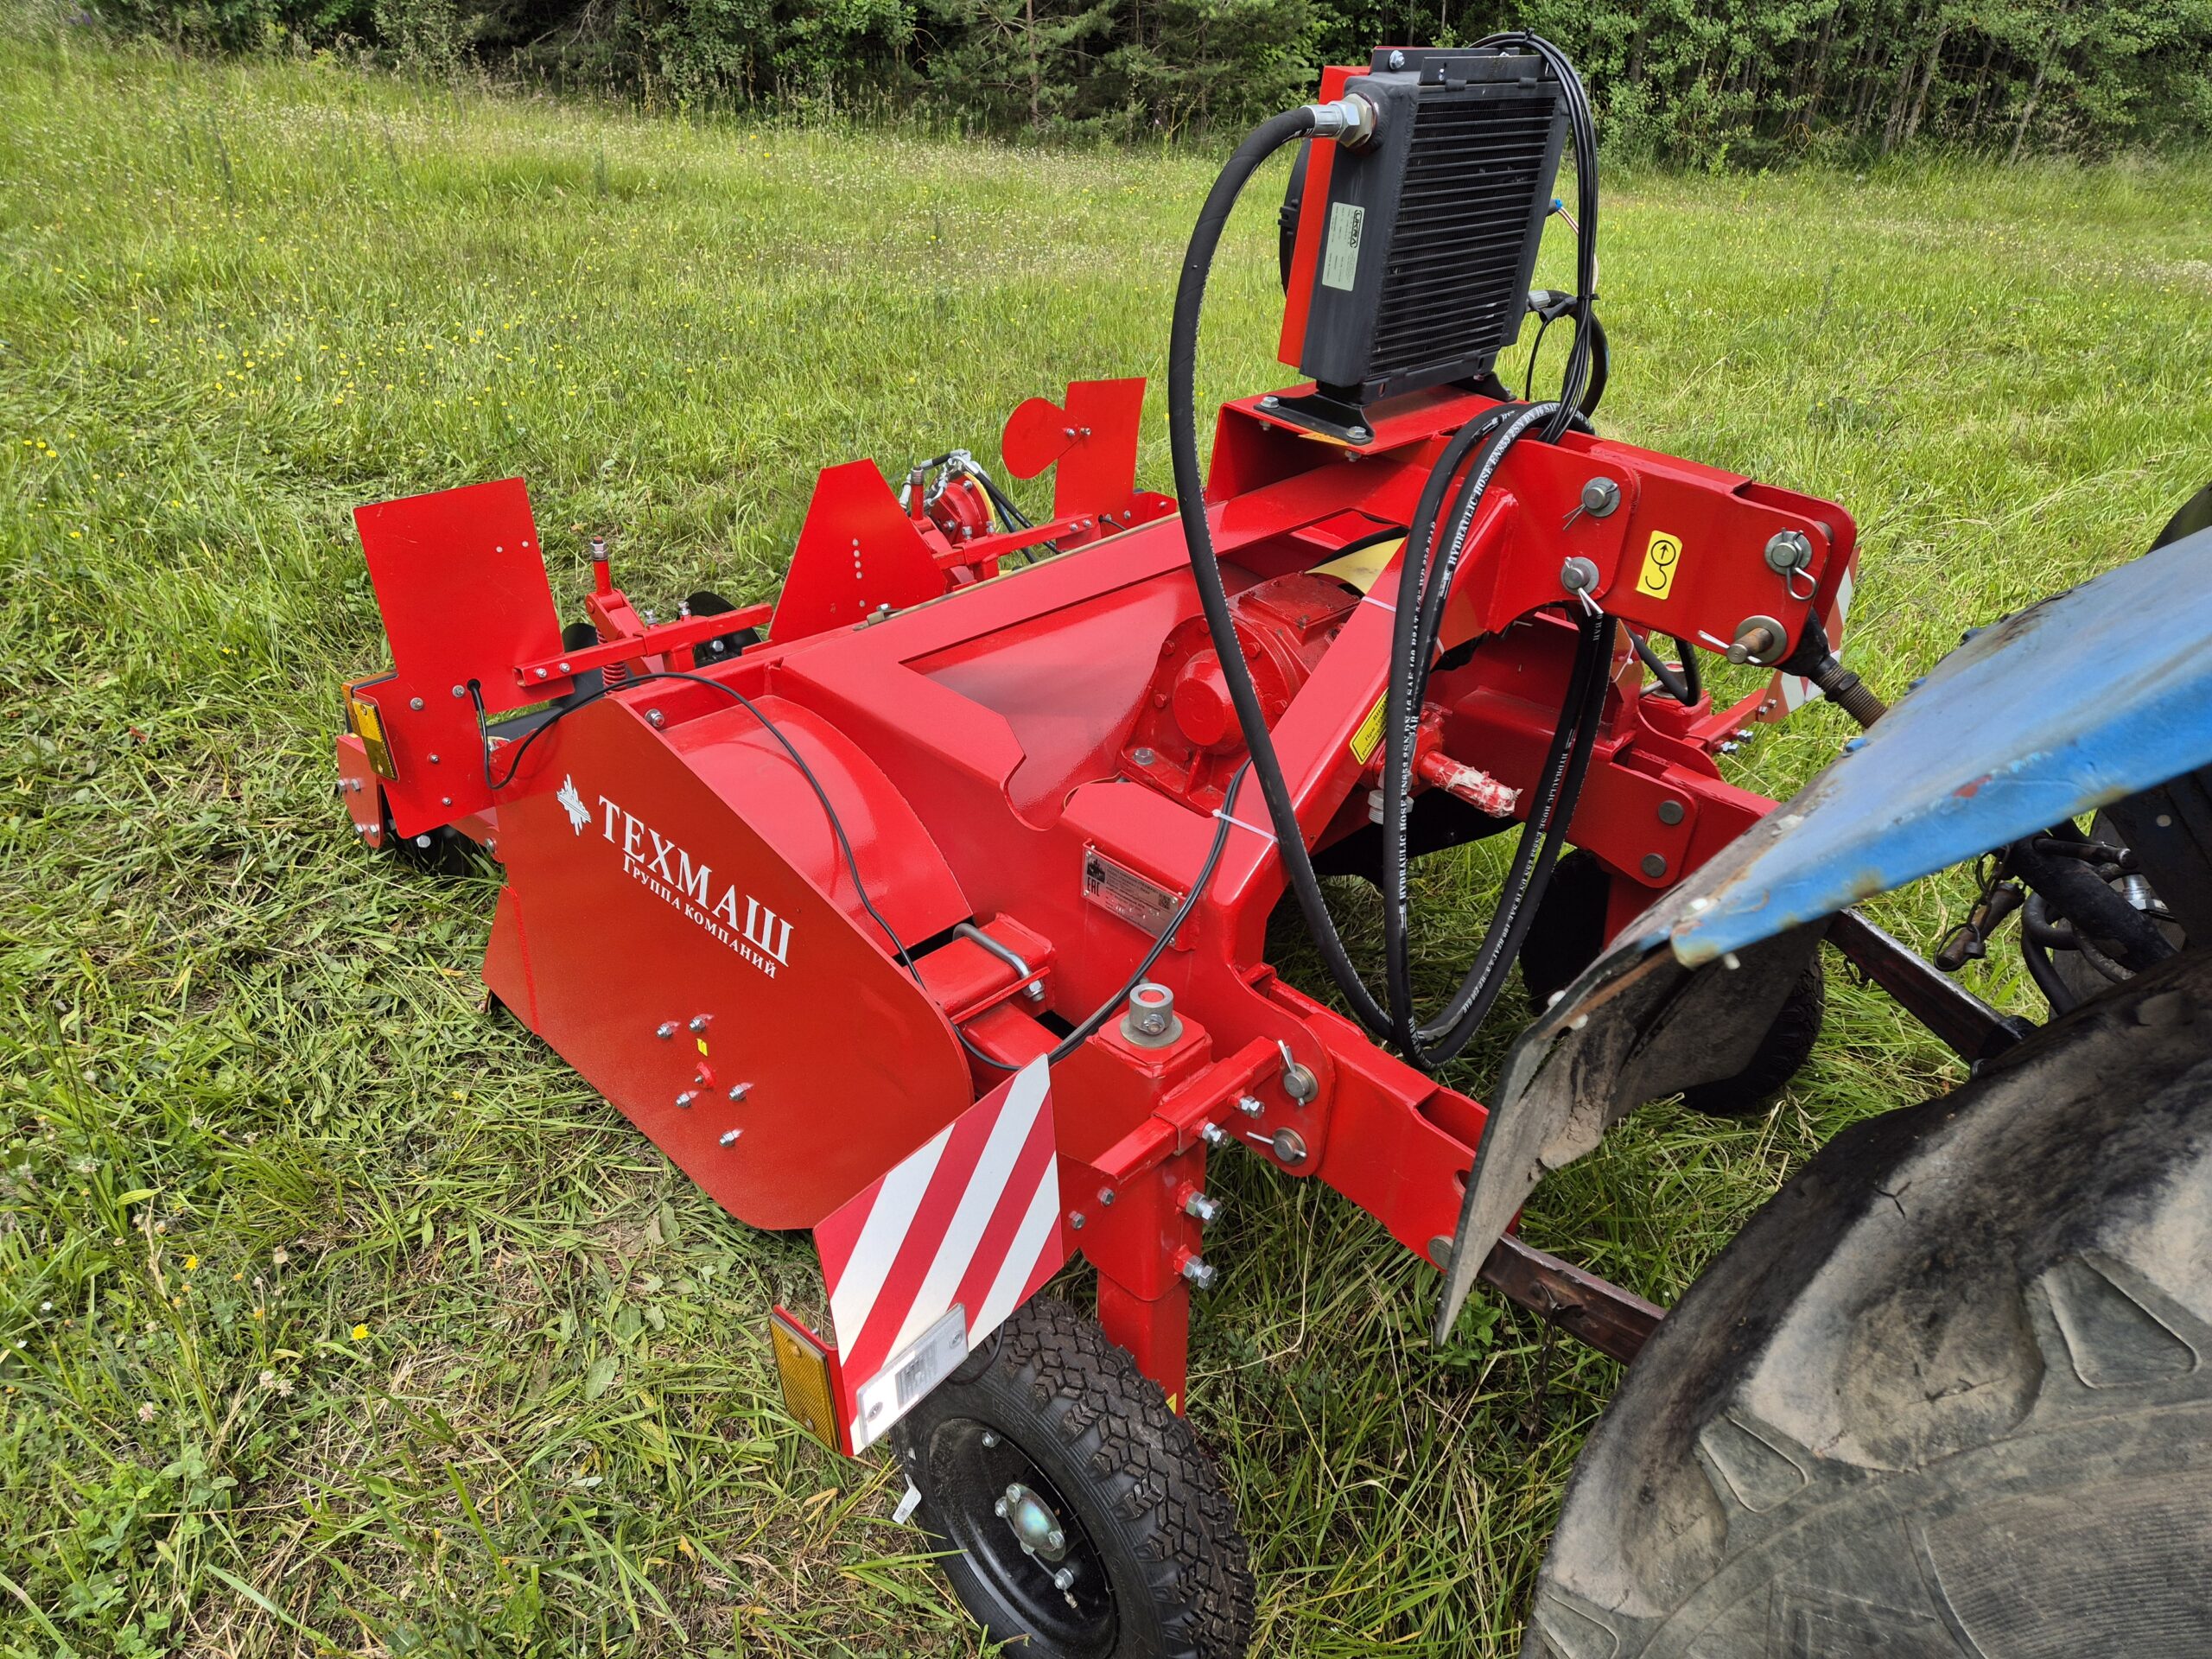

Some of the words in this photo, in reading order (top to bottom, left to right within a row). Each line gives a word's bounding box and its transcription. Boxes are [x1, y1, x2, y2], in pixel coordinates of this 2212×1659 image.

[1448, 493, 1478, 566] HYDRAULIC
[1474, 462, 1494, 496] HOSE
[1490, 434, 1512, 464] EN853
[1508, 417, 1526, 440] 2SN
[1522, 409, 1536, 425] DN
[1535, 405, 1545, 417] 16
[1404, 715, 1412, 732] DN
[1547, 753, 1568, 804] HYDRAULIC
[1540, 805, 1552, 830] HOSE
[598, 794, 795, 968] ТЕХМАШ
